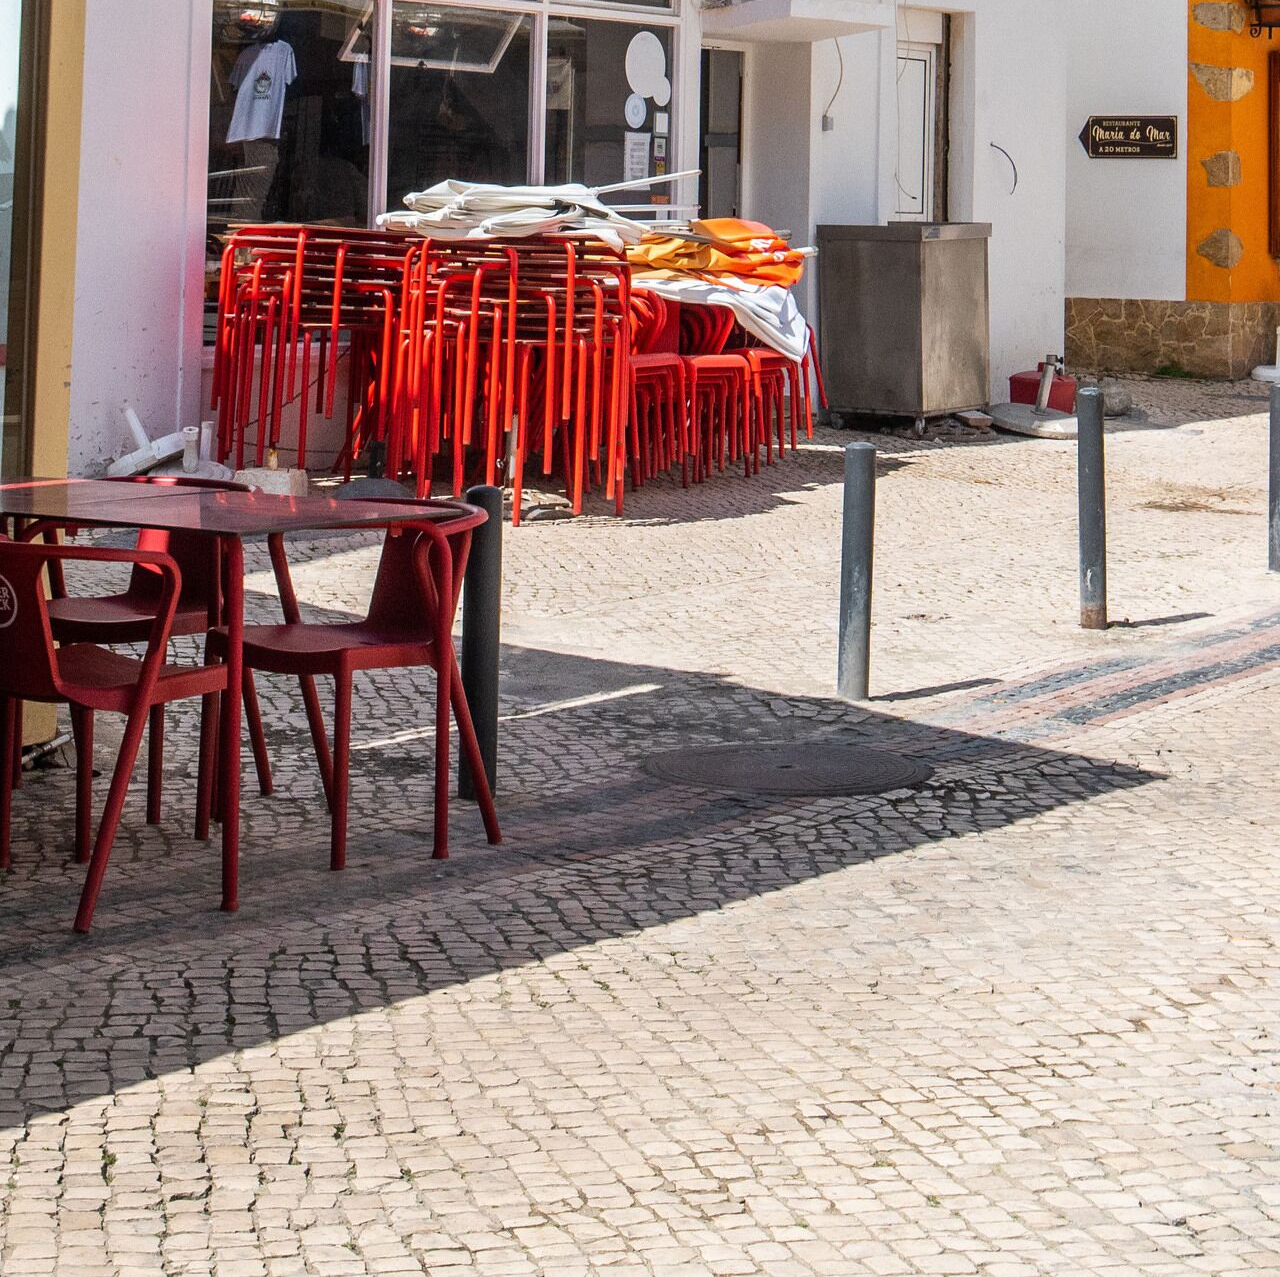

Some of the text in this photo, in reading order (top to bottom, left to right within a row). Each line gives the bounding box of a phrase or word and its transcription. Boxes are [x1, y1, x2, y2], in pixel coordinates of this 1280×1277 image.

[1092, 125, 1171, 142] Maria do Mar
